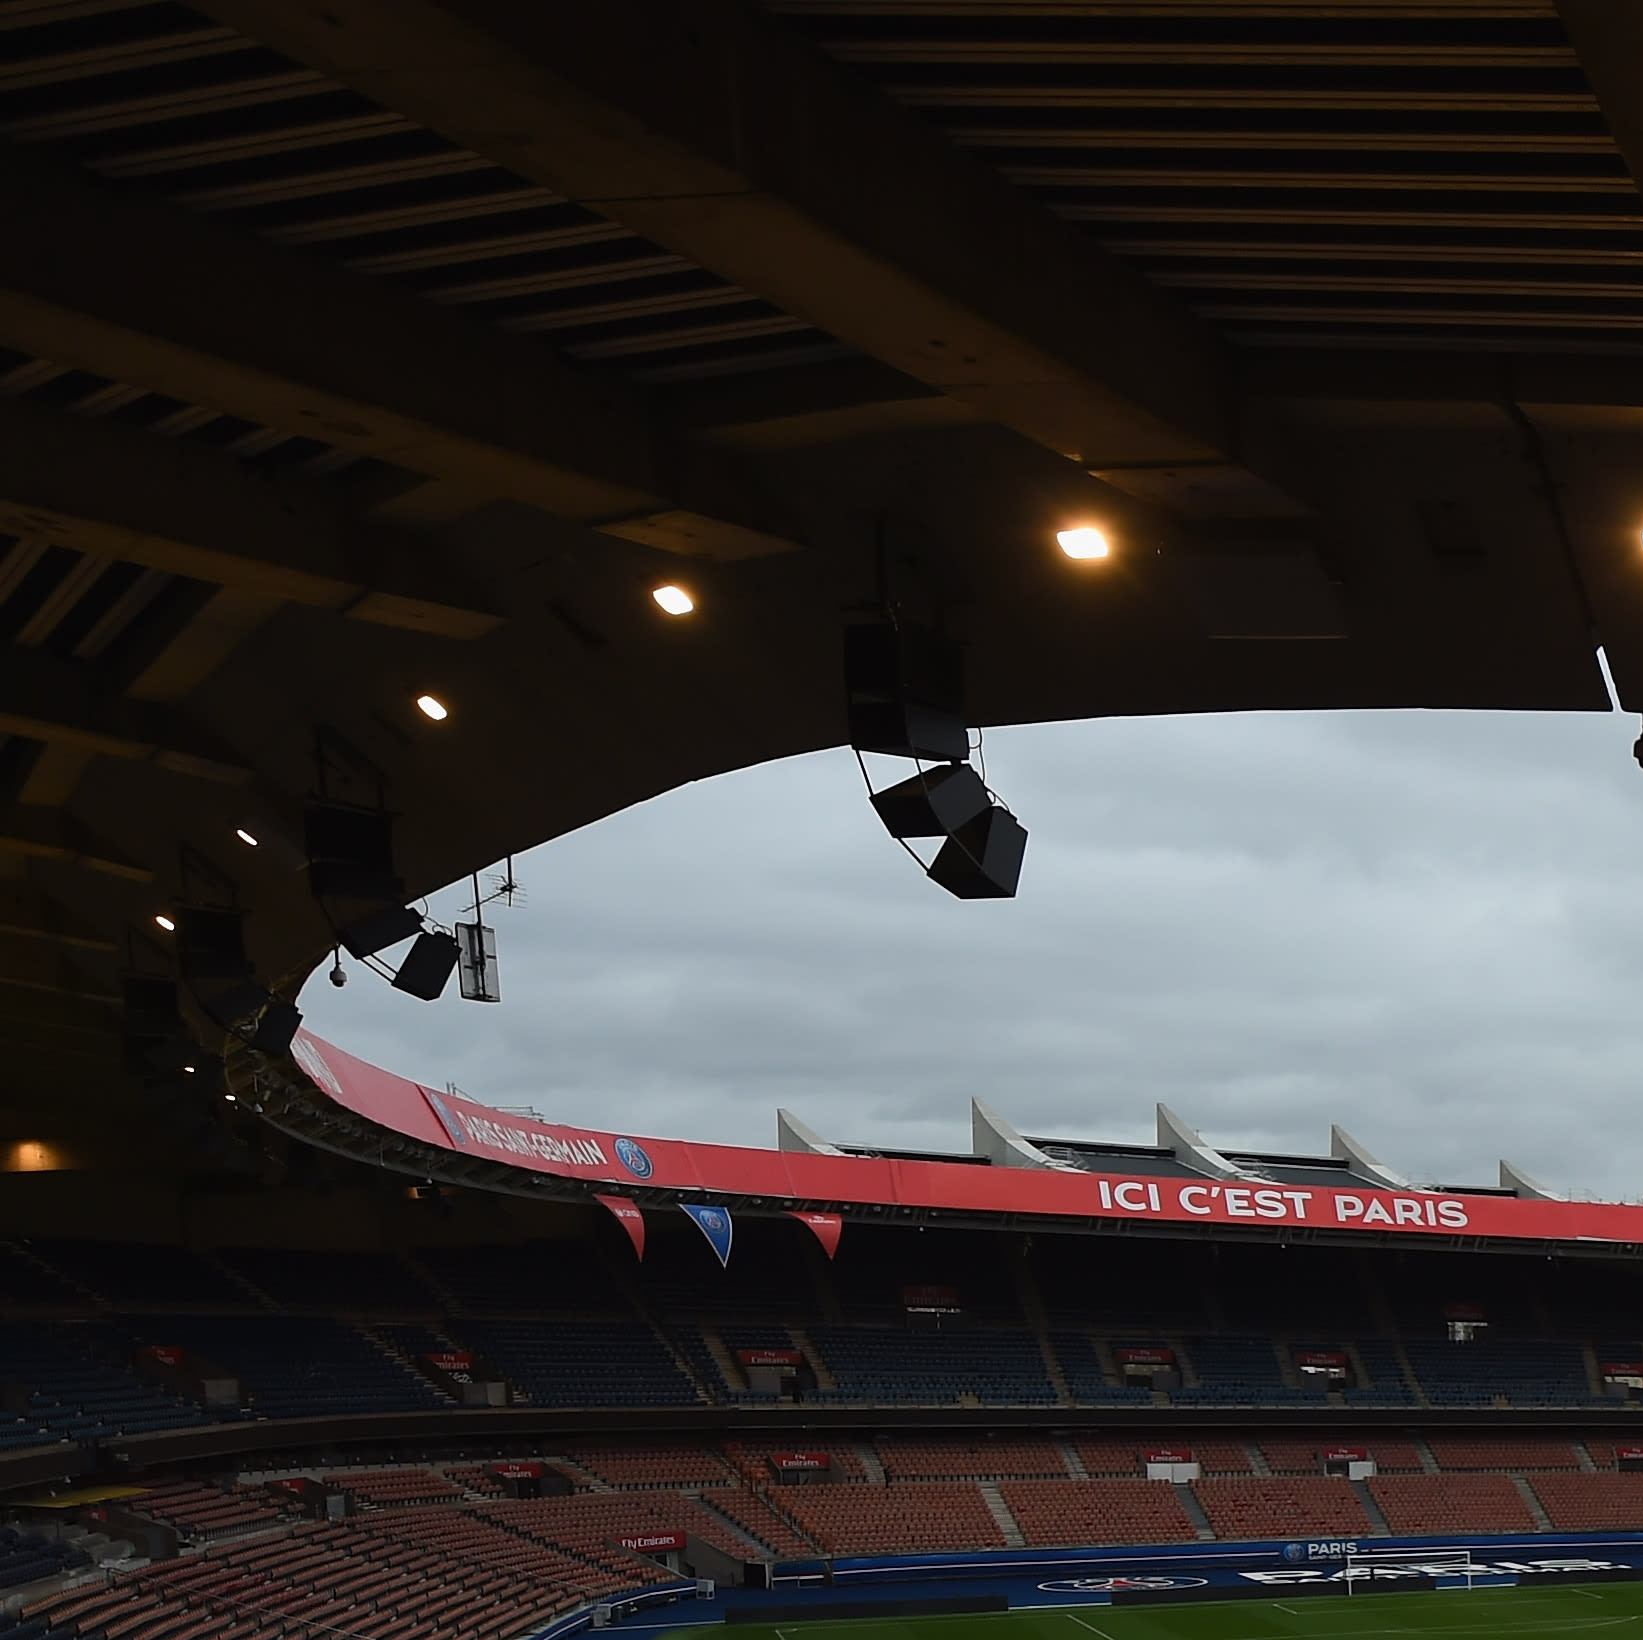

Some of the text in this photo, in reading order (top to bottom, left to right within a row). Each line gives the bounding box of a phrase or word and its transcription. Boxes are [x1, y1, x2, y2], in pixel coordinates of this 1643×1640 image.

[1098, 1180, 1468, 1228] ICI C'EST PARIS
[638, 1536, 675, 1547] Emirates
[1308, 1542, 1358, 1555] PARIS
